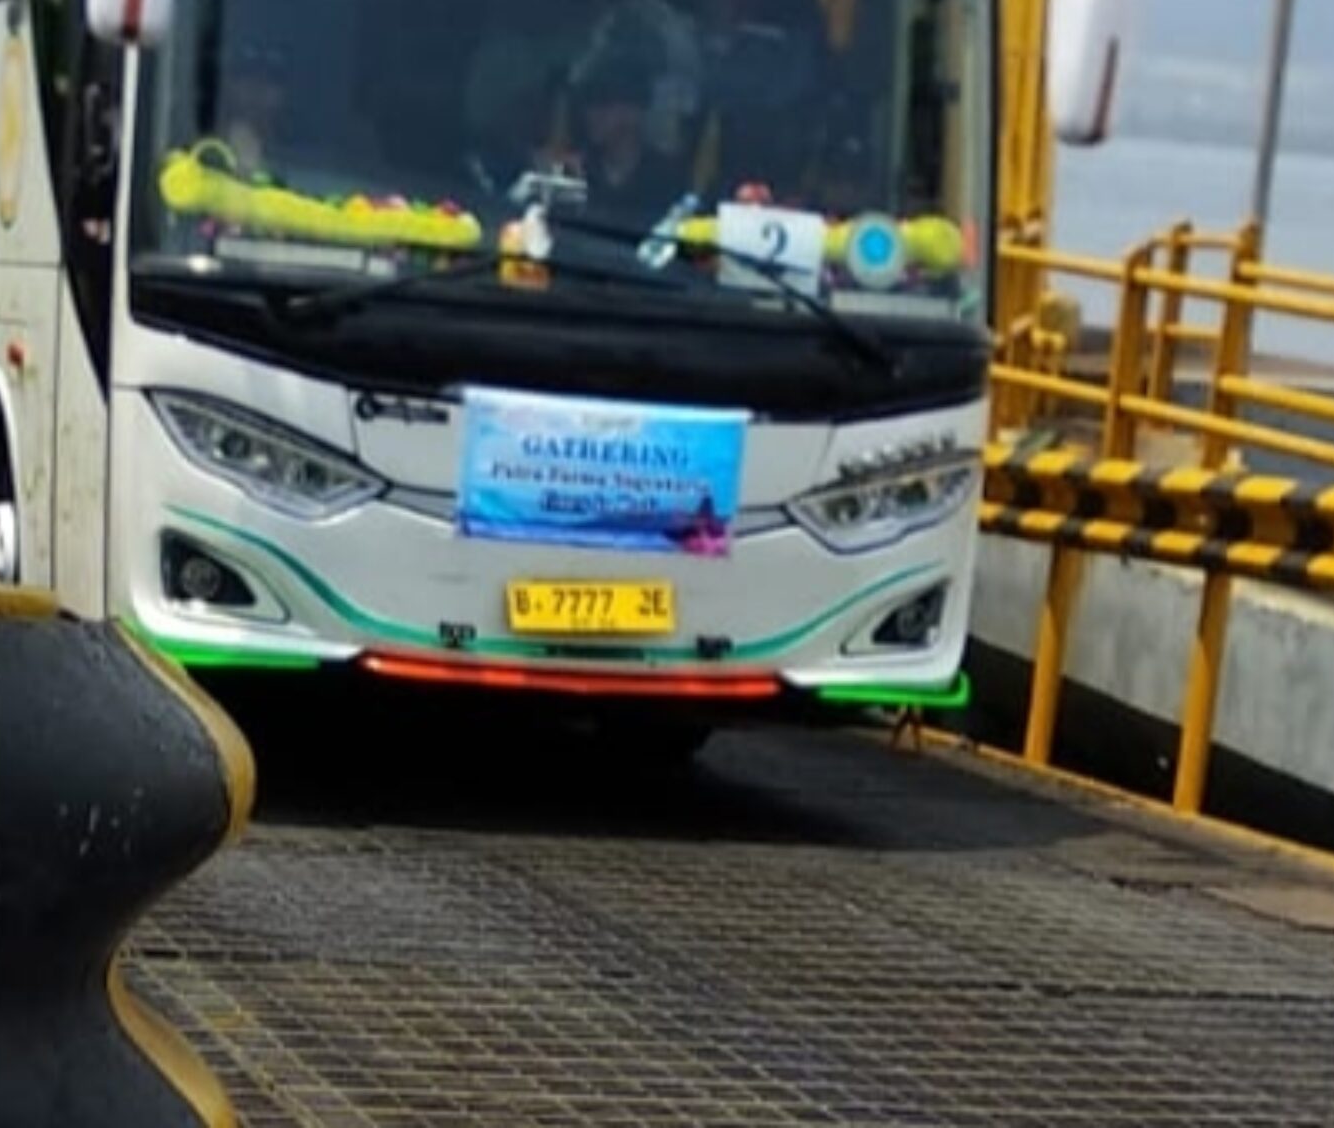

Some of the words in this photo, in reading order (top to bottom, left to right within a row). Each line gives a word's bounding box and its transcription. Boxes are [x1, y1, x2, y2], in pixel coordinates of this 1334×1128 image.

[760, 221, 789, 272] 2
[522, 434, 689, 470] GATHERING
[552, 587, 615, 616] 7777
